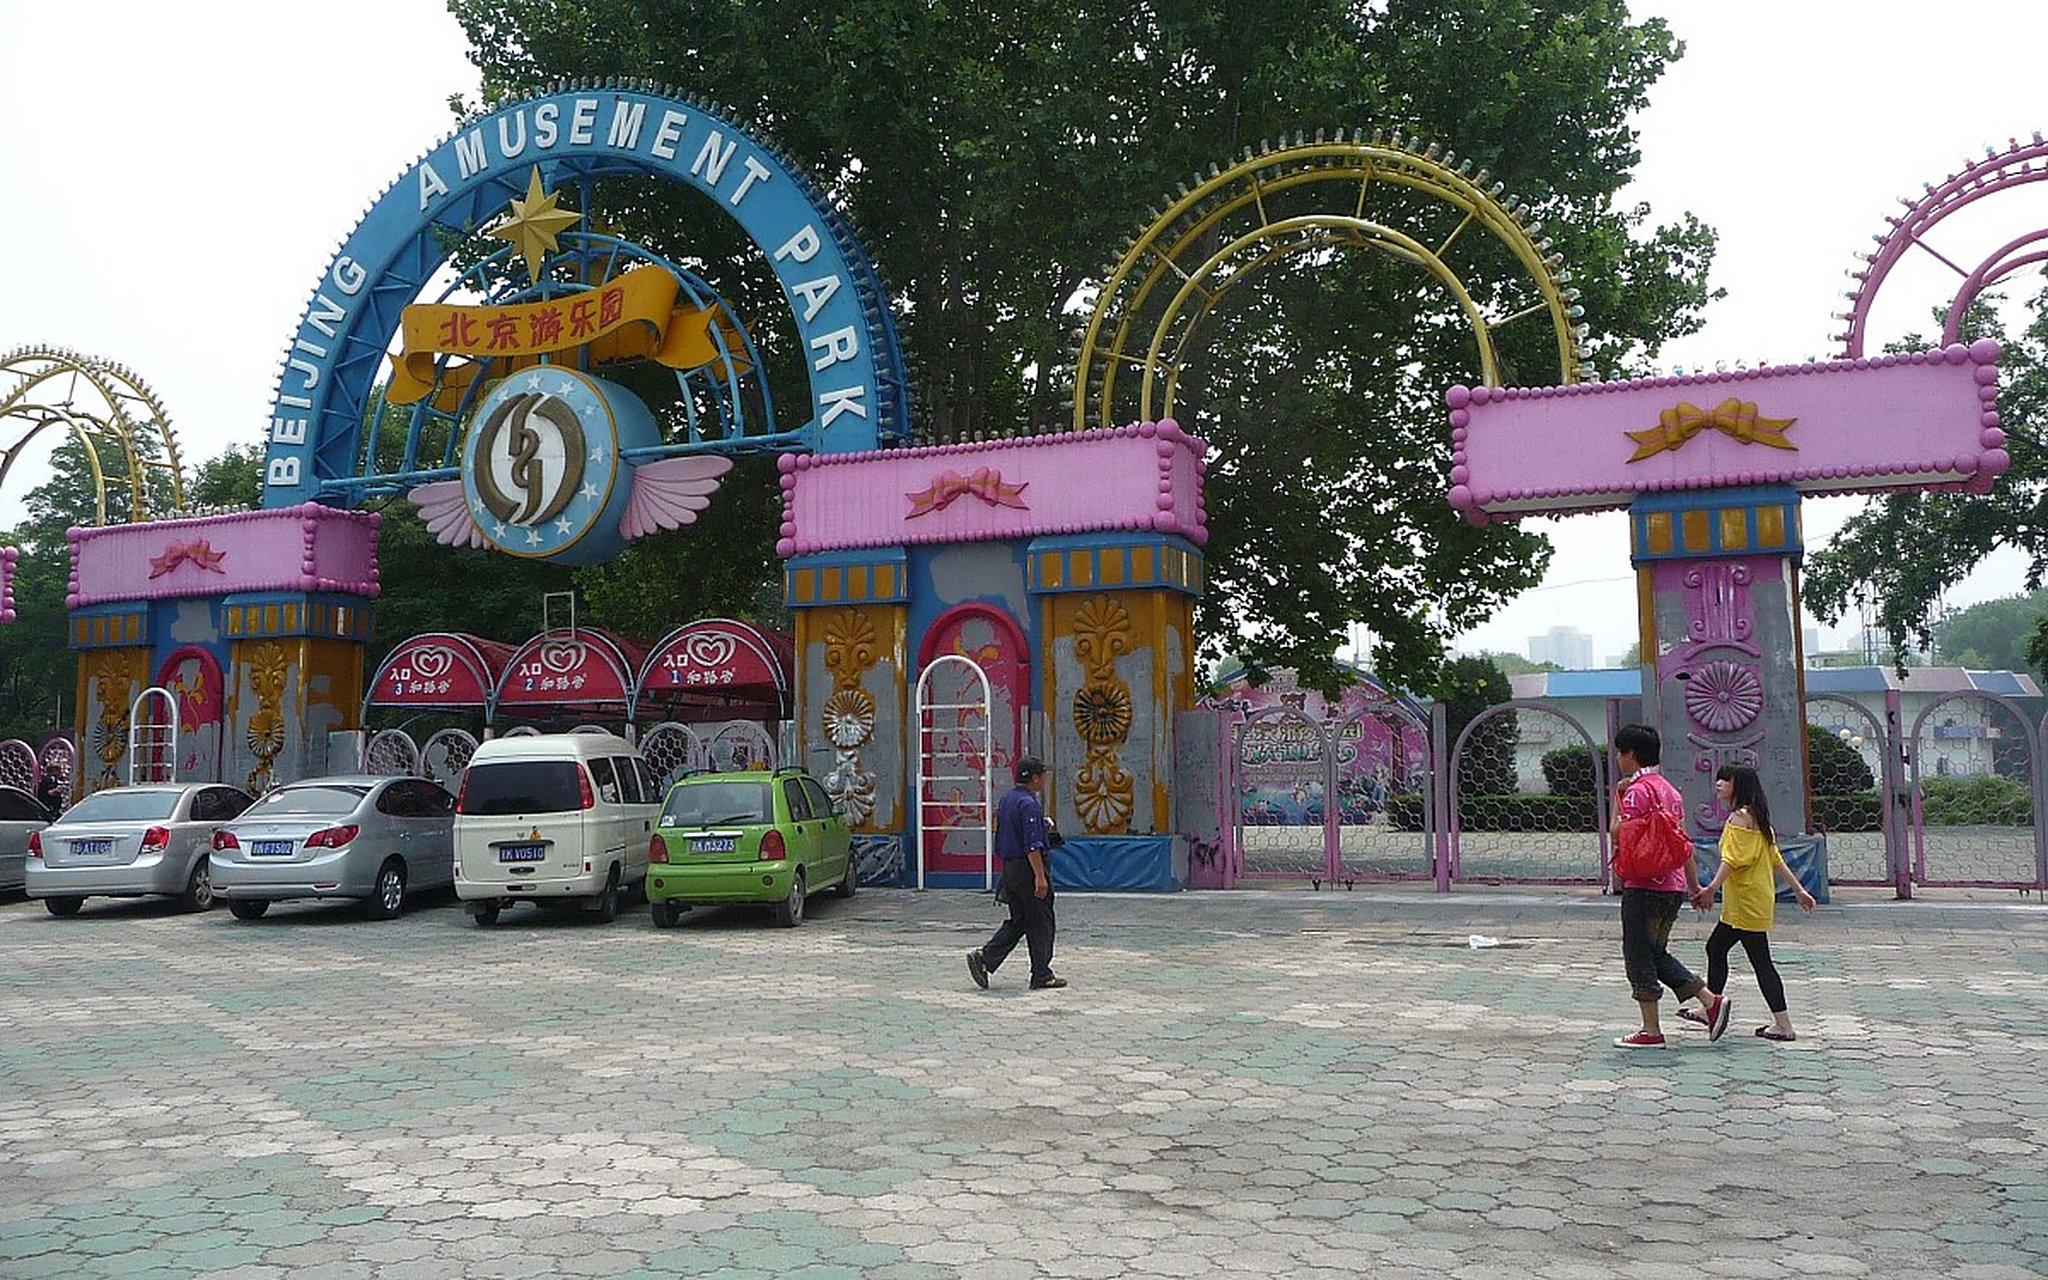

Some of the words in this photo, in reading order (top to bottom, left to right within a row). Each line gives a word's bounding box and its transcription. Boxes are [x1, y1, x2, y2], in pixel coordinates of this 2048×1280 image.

[267, 254, 367, 487] BEIJING
[417, 97, 772, 210] AMUSEMENT
[773, 223, 868, 428] PARK
[439, 286, 625, 349] 北京游乐园
[662, 653, 689, 668] 入口
[389, 668, 411, 680] 入口
[519, 663, 542, 676] 入口
[671, 669, 679, 683] 1
[395, 683, 402, 696] 3
[525, 678, 534, 691] 2
